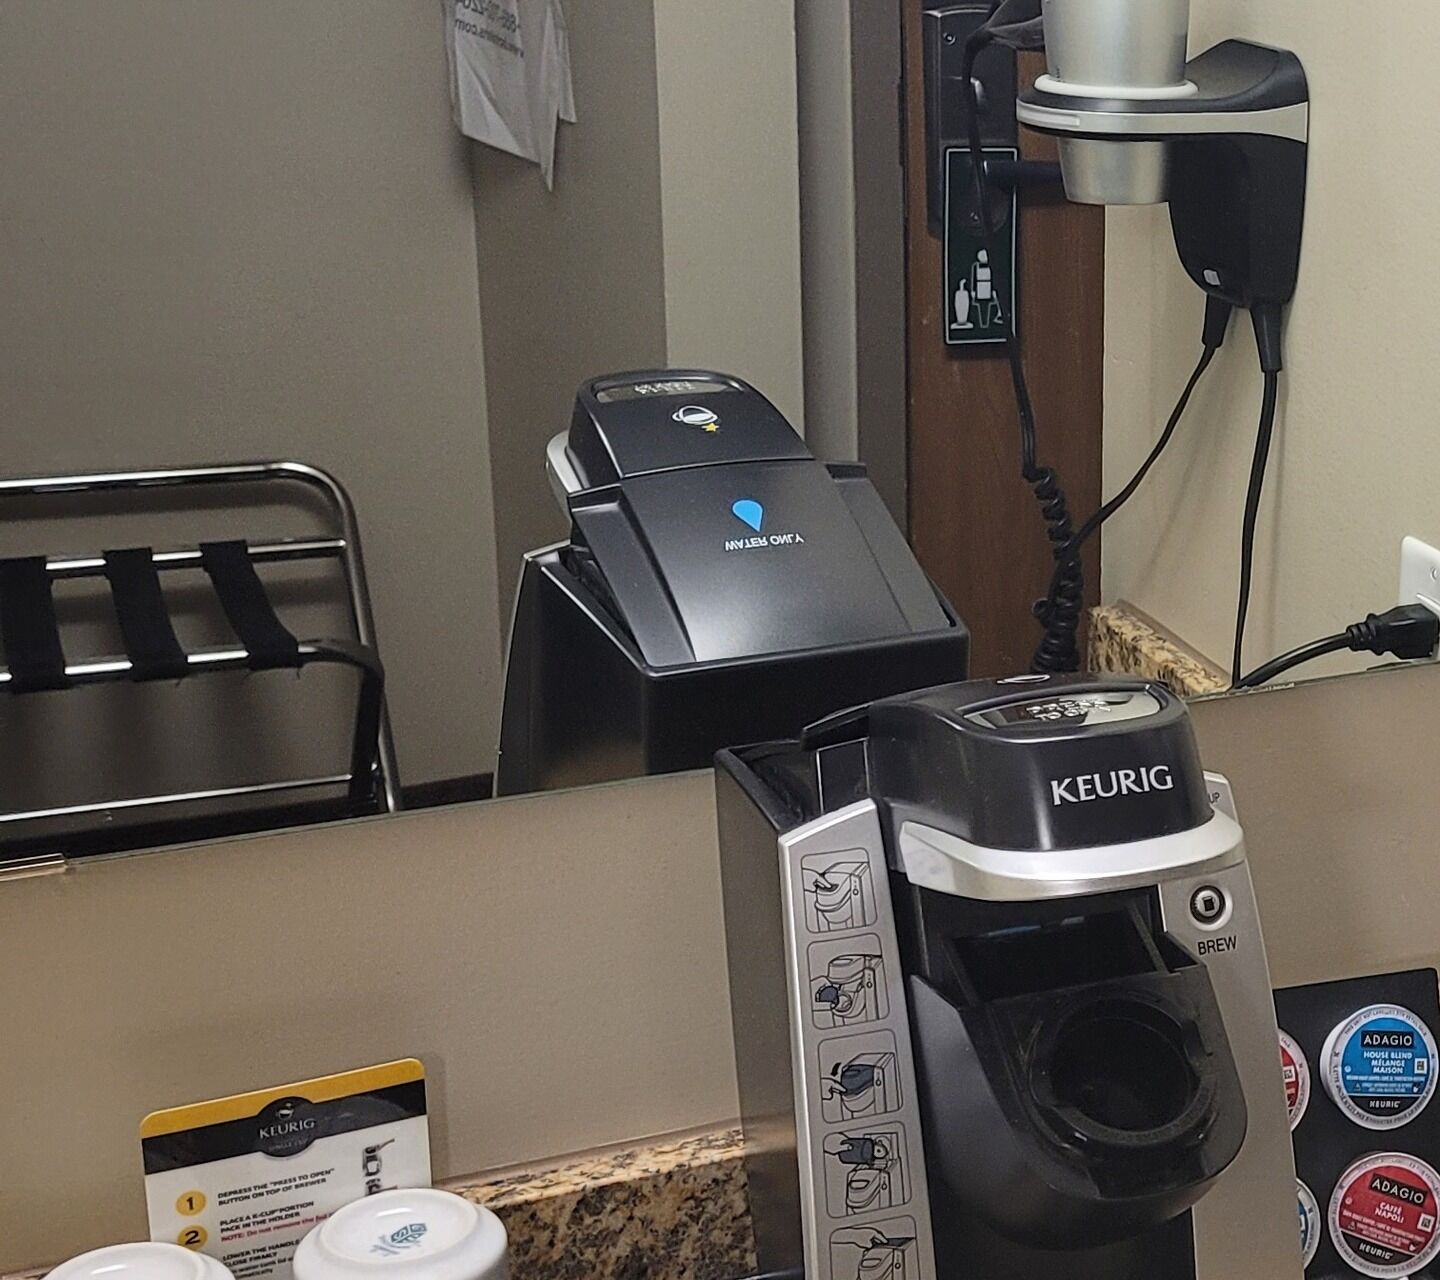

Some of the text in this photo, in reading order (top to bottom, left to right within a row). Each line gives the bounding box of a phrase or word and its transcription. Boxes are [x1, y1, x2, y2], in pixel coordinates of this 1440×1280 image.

[1050, 765, 1174, 805] KEURIG
[1198, 936, 1236, 956] BREW
[1363, 1035, 1413, 1046] ADAGIO
[1363, 1051, 1389, 1059] HOUSE
[260, 1119, 315, 1139] KEURIG
[218, 1195, 250, 1206] BUTTON
[252, 1191, 264, 1199] ON
[265, 1187, 281, 1196] TOP
[1371, 1178, 1424, 1204] ADAGIO
[186, 1196, 195, 1211] 1
[1375, 1208, 1404, 1223] NAPOLI
[185, 1230, 200, 1245] 2
[1359, 1242, 1391, 1260] KEURIG
